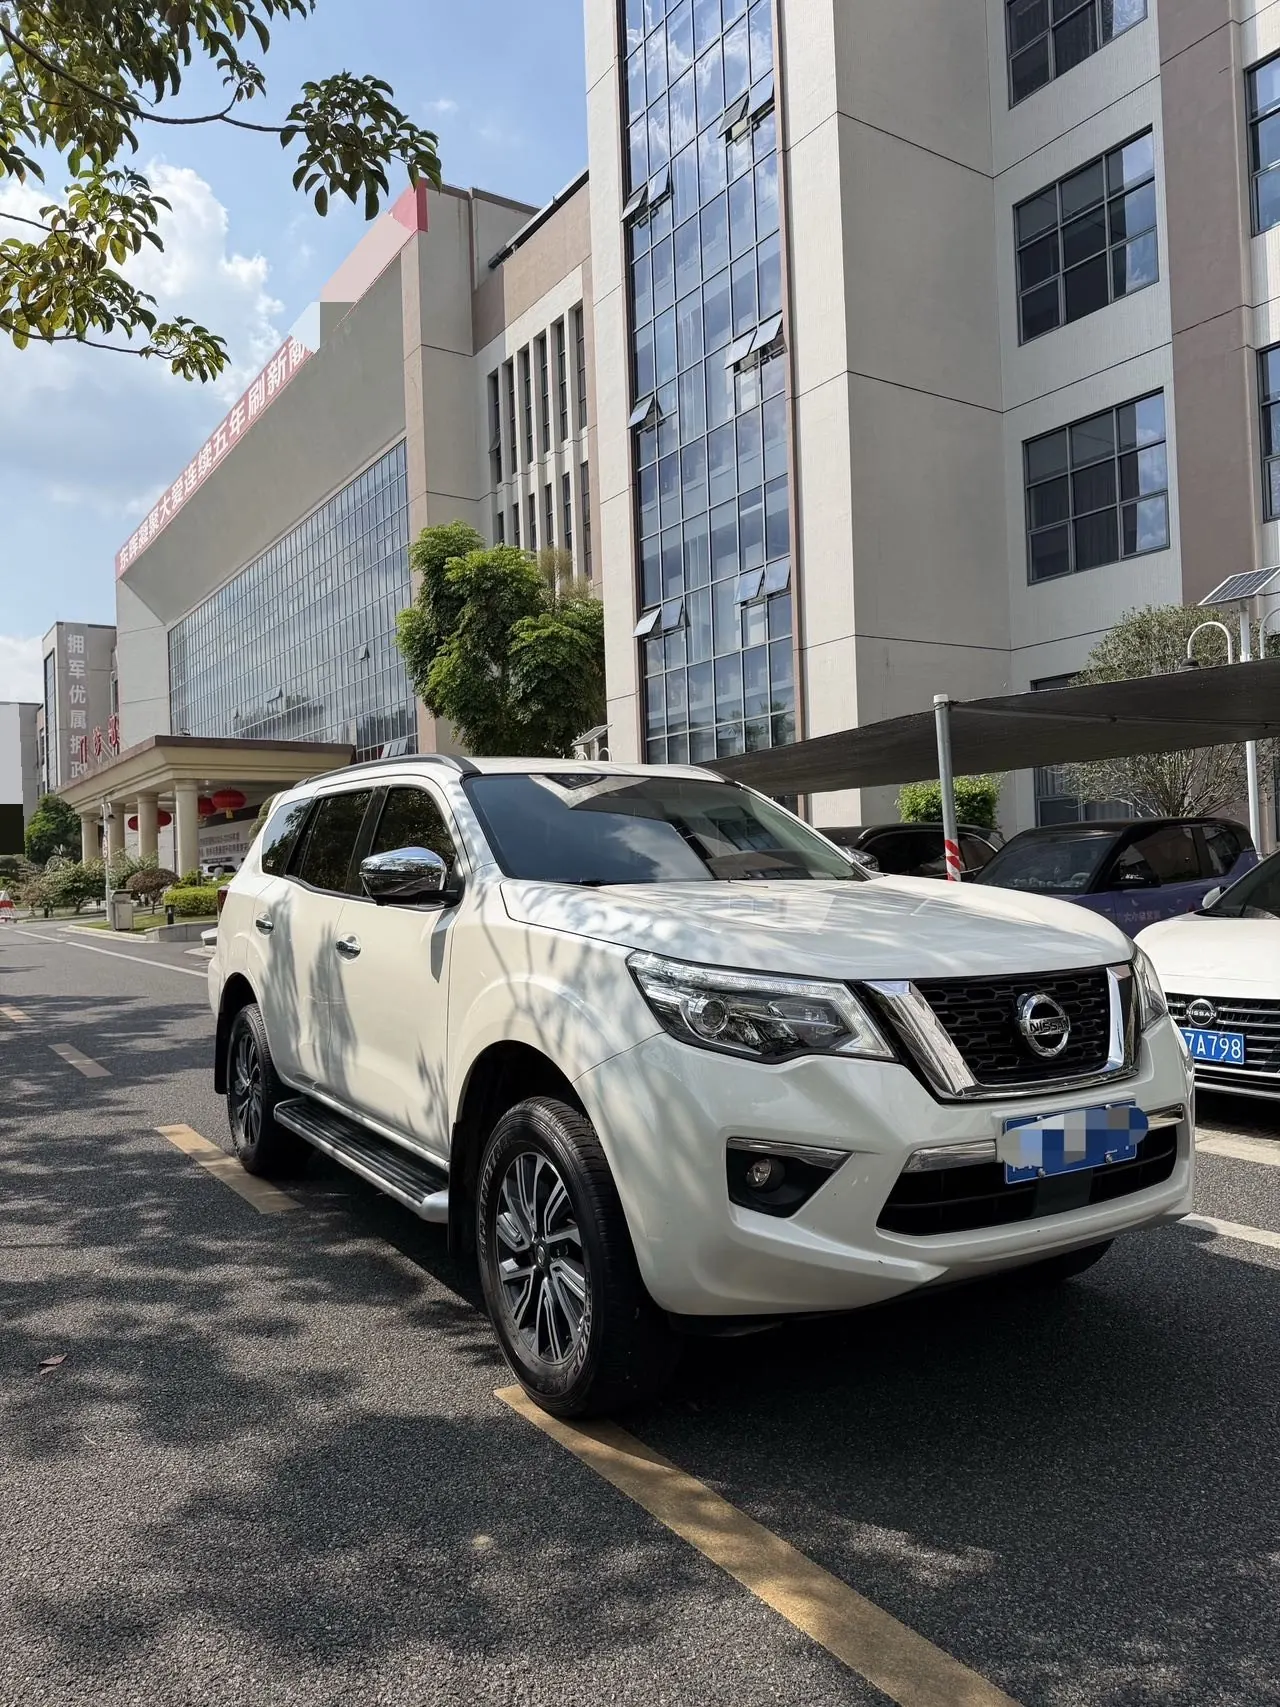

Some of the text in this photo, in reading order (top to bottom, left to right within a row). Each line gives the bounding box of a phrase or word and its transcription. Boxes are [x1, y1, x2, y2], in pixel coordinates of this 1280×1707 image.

[1186, 1009, 1217, 1018] NISSAN
[1029, 1018, 1070, 1033] NISSAN
[1185, 1032, 1241, 1059] 7A798
